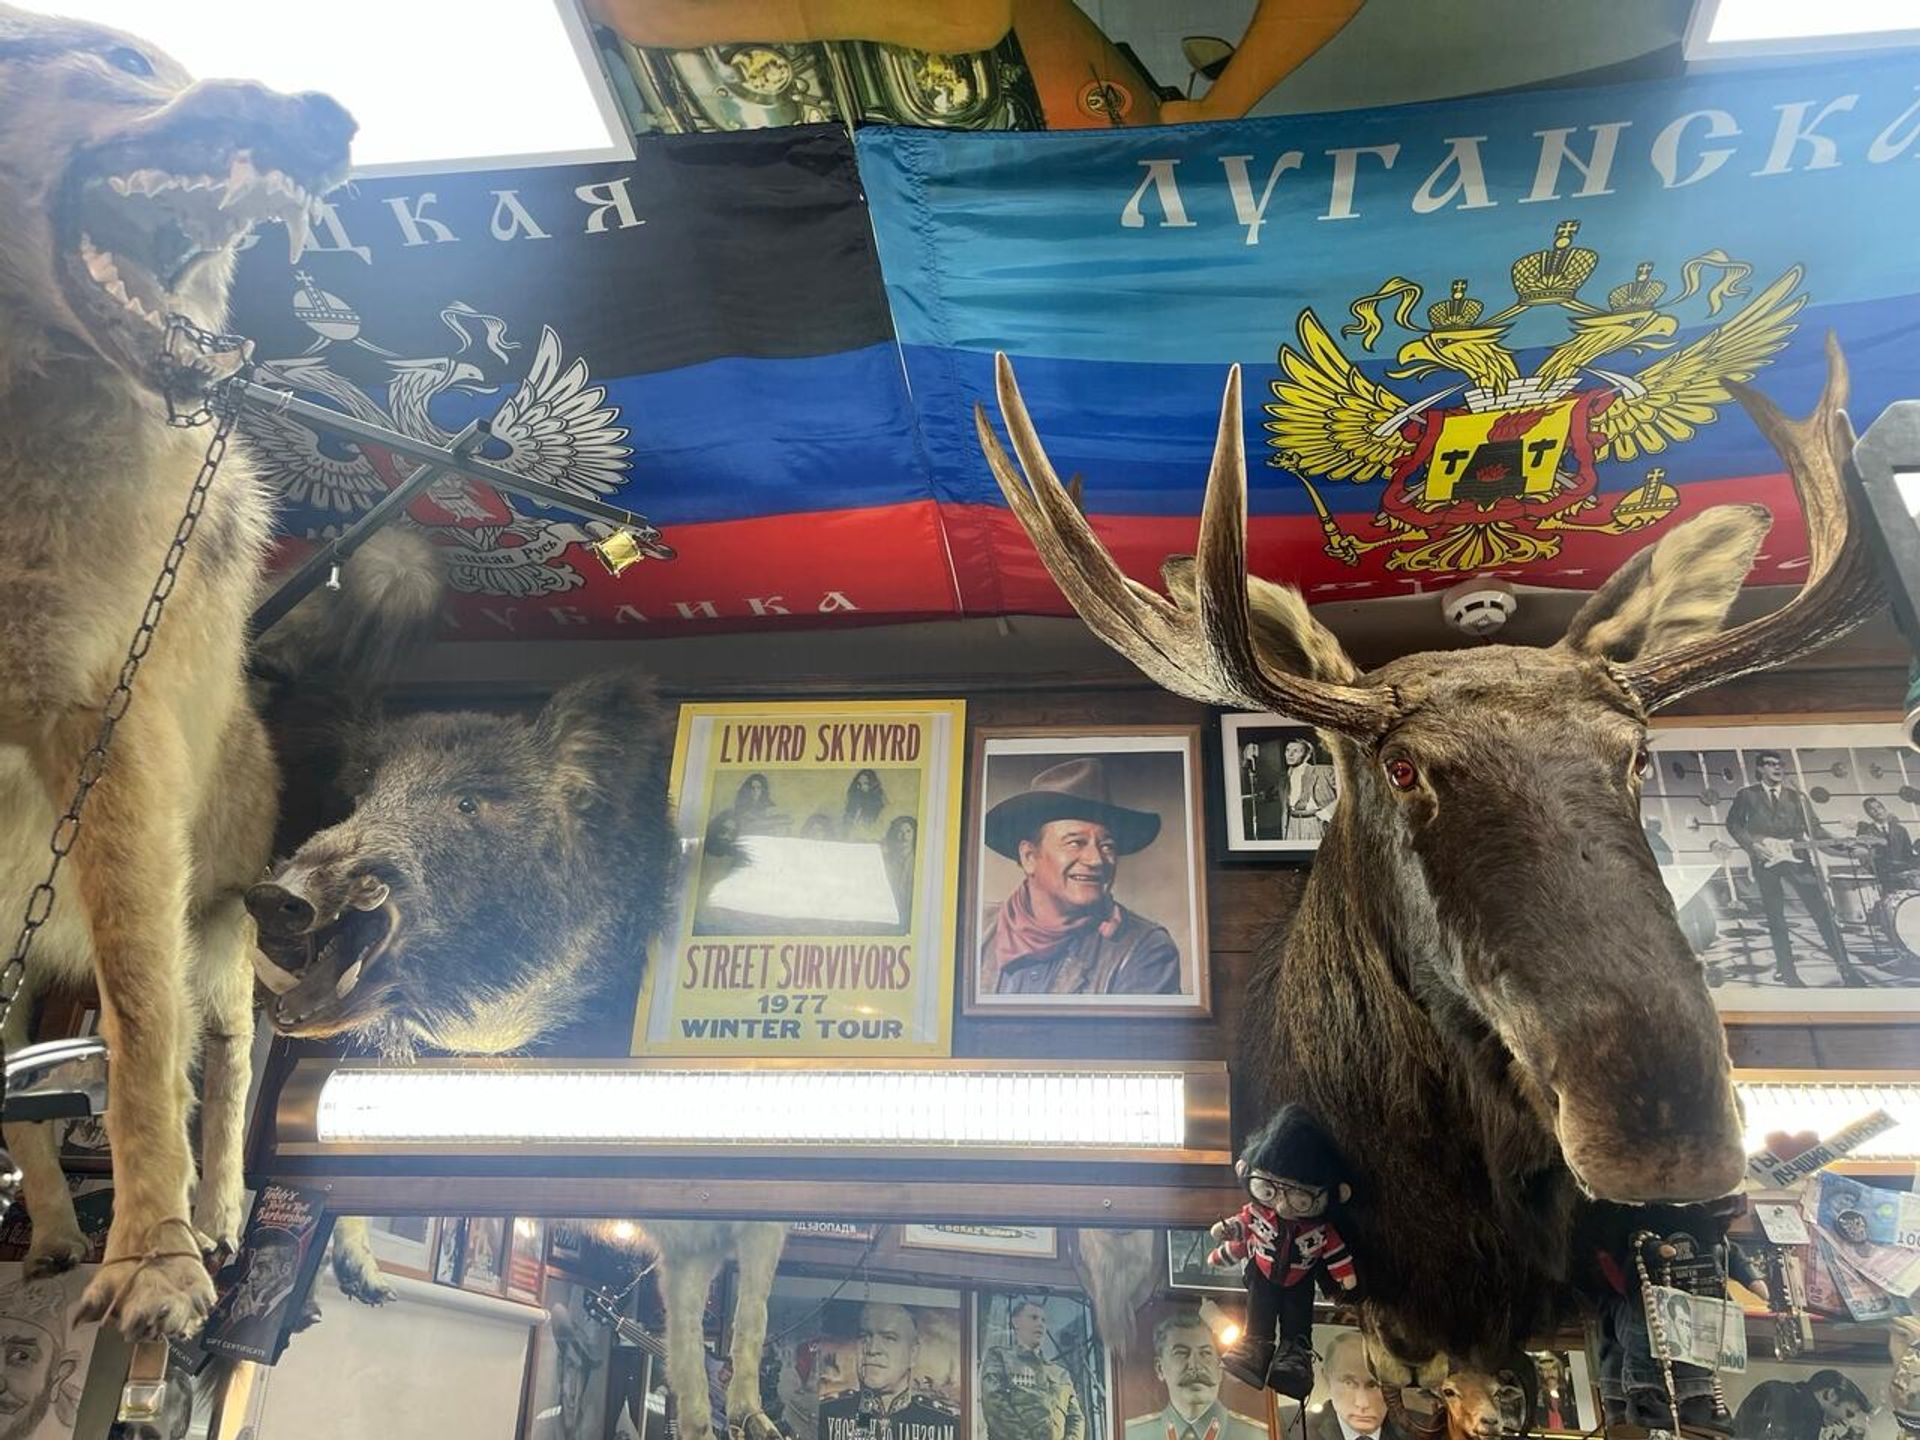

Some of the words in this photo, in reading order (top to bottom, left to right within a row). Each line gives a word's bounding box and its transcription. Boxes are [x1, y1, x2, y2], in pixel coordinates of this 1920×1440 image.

[521, 538, 558, 562] Русь
[720, 724, 806, 763] LYNYRD
[816, 723, 921, 763] SKYNYRD
[682, 944, 775, 991] STREET
[777, 944, 911, 991] SURVIVORS
[757, 995, 828, 1015] 1977
[681, 1018, 801, 1039] WINTER
[815, 1019, 904, 1039] TOUR
